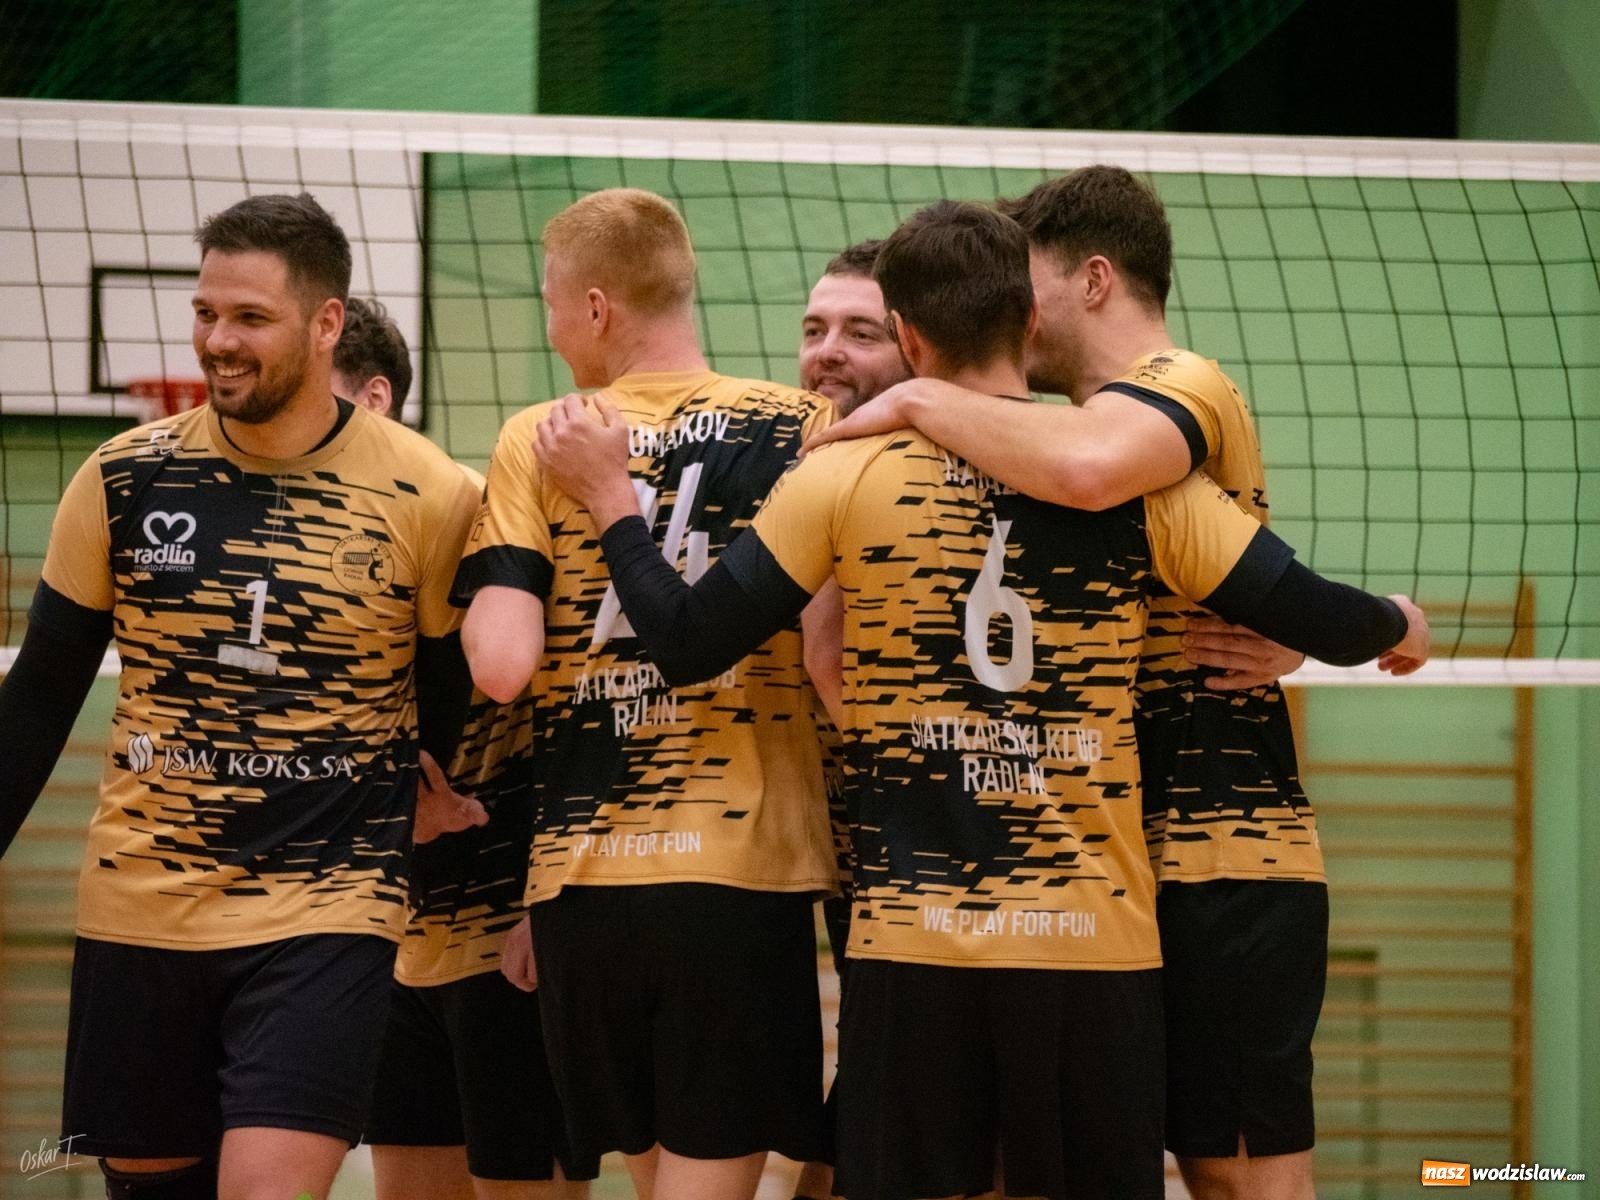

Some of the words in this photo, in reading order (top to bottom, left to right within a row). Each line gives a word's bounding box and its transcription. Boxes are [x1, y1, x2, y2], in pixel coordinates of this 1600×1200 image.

[628, 411, 730, 458] UMAKOV
[134, 543, 196, 565] radlin
[246, 580, 269, 645] 1
[965, 513, 1034, 692] 6
[911, 714, 1039, 759] SIATKARSKI
[161, 744, 218, 775] JSW
[228, 751, 311, 779] KOKS
[320, 755, 353, 779] SA
[963, 758, 1047, 796] RADLIN
[624, 833, 658, 856] FOR
[663, 831, 701, 853] FUN
[923, 905, 953, 933] WE
[958, 909, 1007, 936] PLAY
[1011, 911, 1051, 936] FOR
[1058, 912, 1096, 937] FUN
